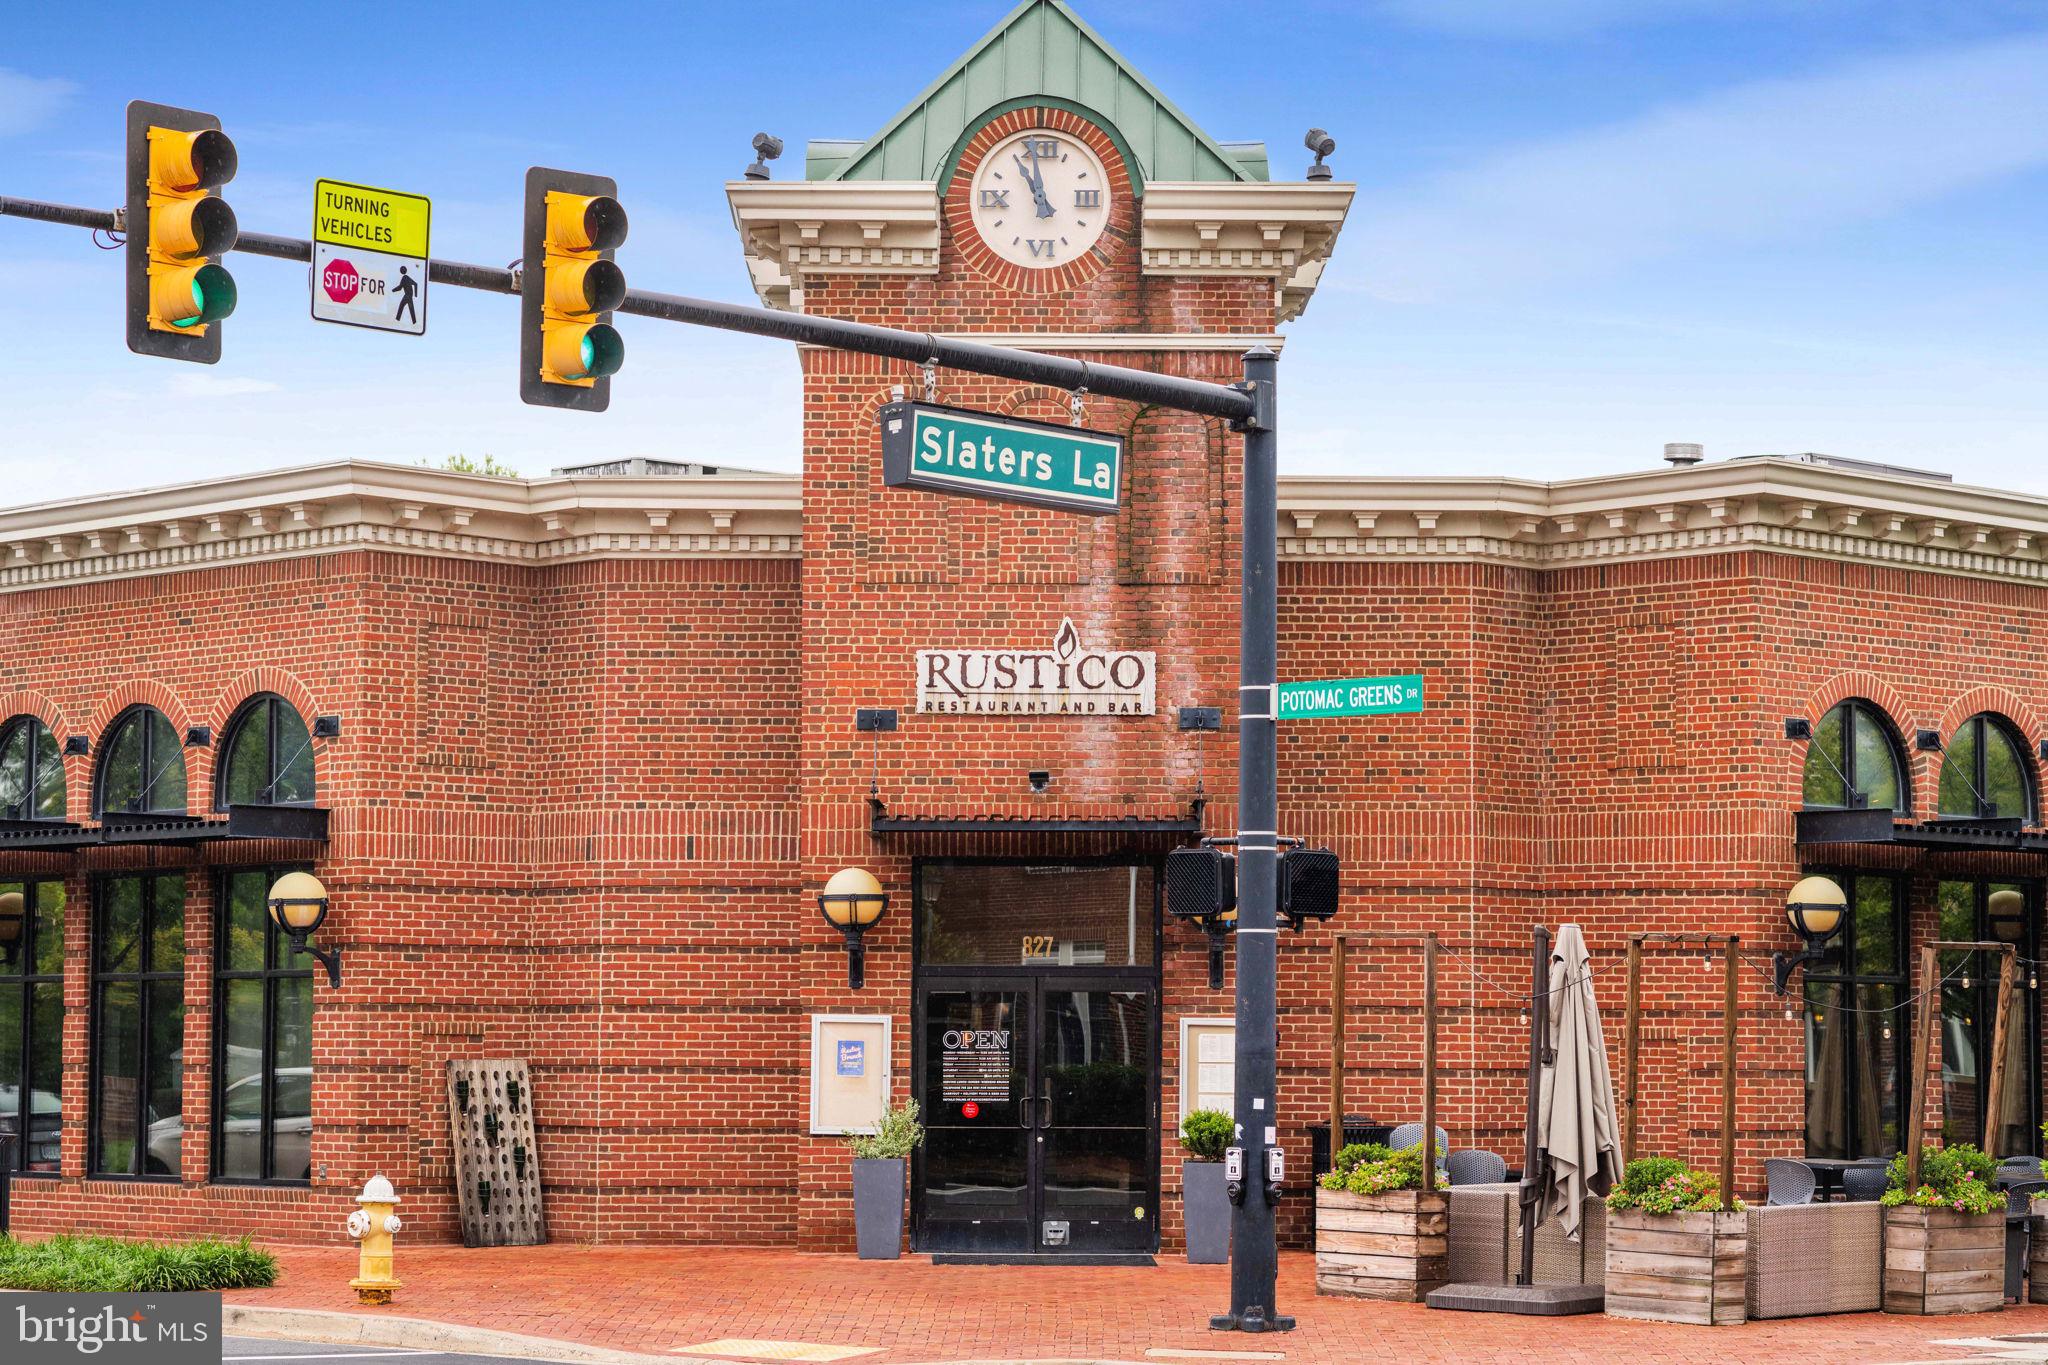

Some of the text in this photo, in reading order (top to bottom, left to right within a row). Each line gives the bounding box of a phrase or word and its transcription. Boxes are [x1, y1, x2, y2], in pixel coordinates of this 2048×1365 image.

[325, 192, 390, 218] TURNING
[980, 190, 1009, 208] IX
[1074, 190, 1100, 208] III
[321, 216, 393, 244] VEHICLES
[1026, 239, 1055, 257] VI
[324, 271, 385, 296] STOP FOR
[920, 425, 1111, 490] Slaters La
[925, 701, 1142, 713] RESTAURANT AND BAR
[1281, 684, 1418, 712] POTOMAC GREENS DR
[1022, 935, 1054, 957] 827
[942, 1030, 1010, 1049] OPEN
